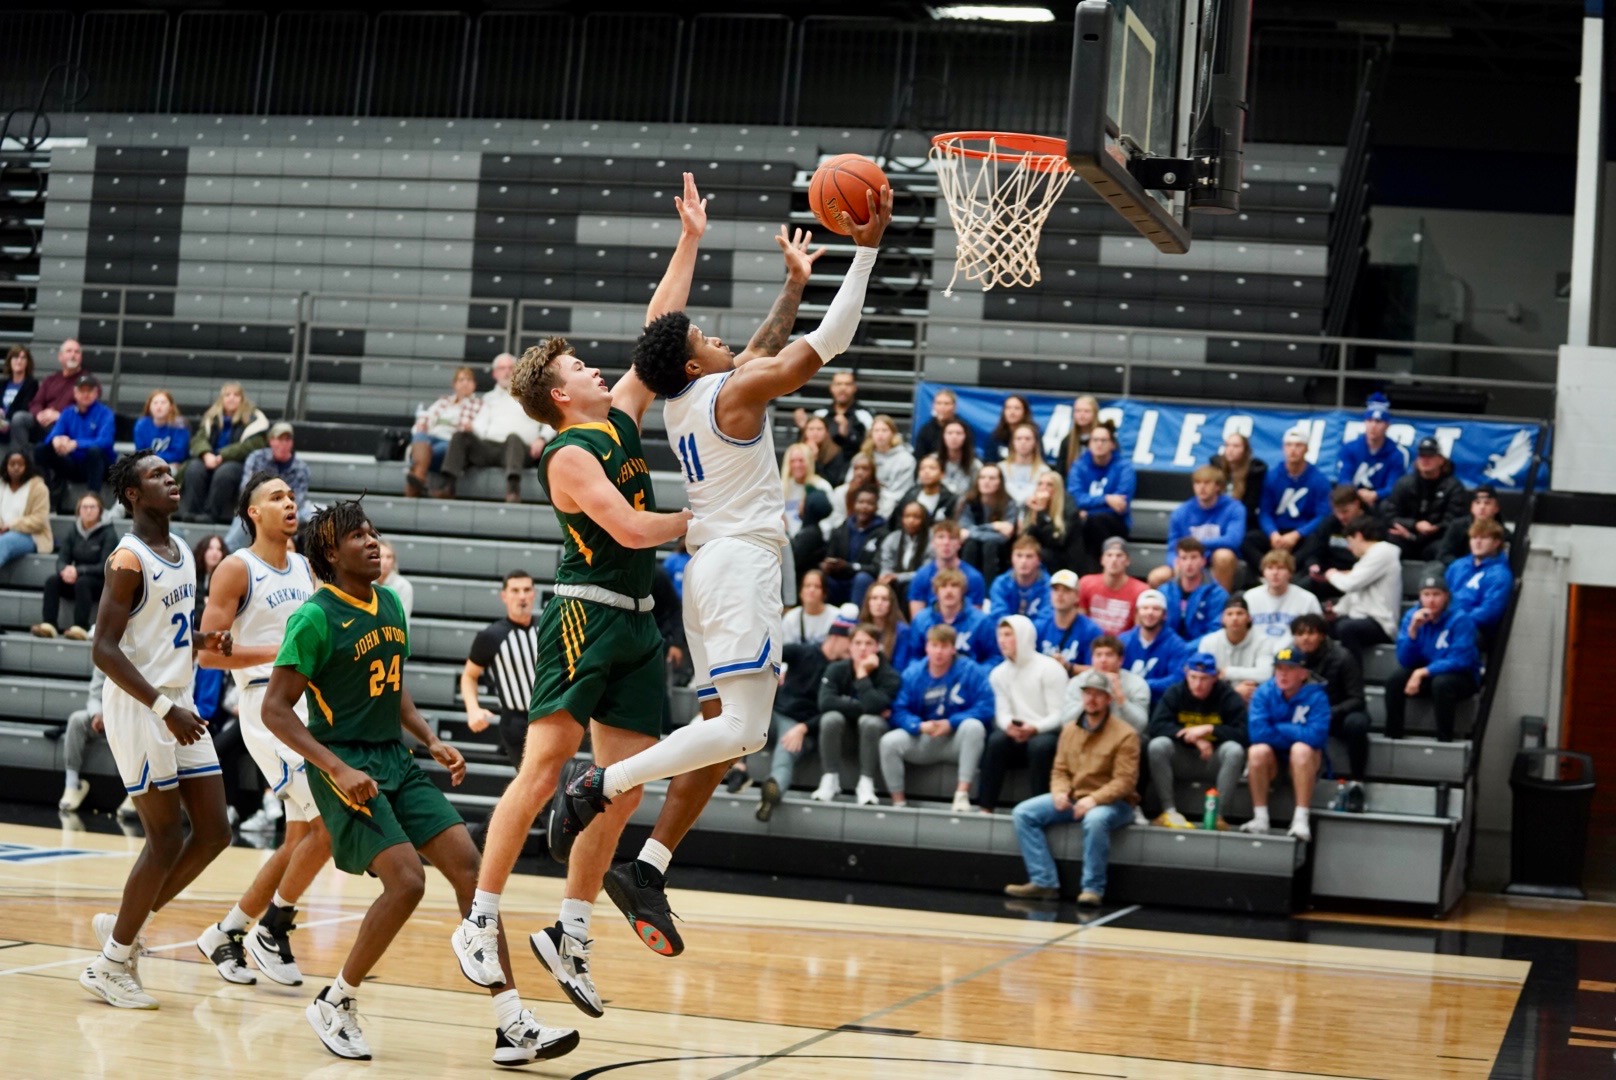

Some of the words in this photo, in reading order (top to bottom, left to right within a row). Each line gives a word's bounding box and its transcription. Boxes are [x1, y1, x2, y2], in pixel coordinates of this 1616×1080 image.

[679, 432, 704, 483] 11
[1354, 462, 1384, 488] K
[1276, 487, 1309, 518] K
[354, 629, 380, 661] JOHN
[369, 654, 401, 697] 24
[1292, 705, 1311, 724] K
